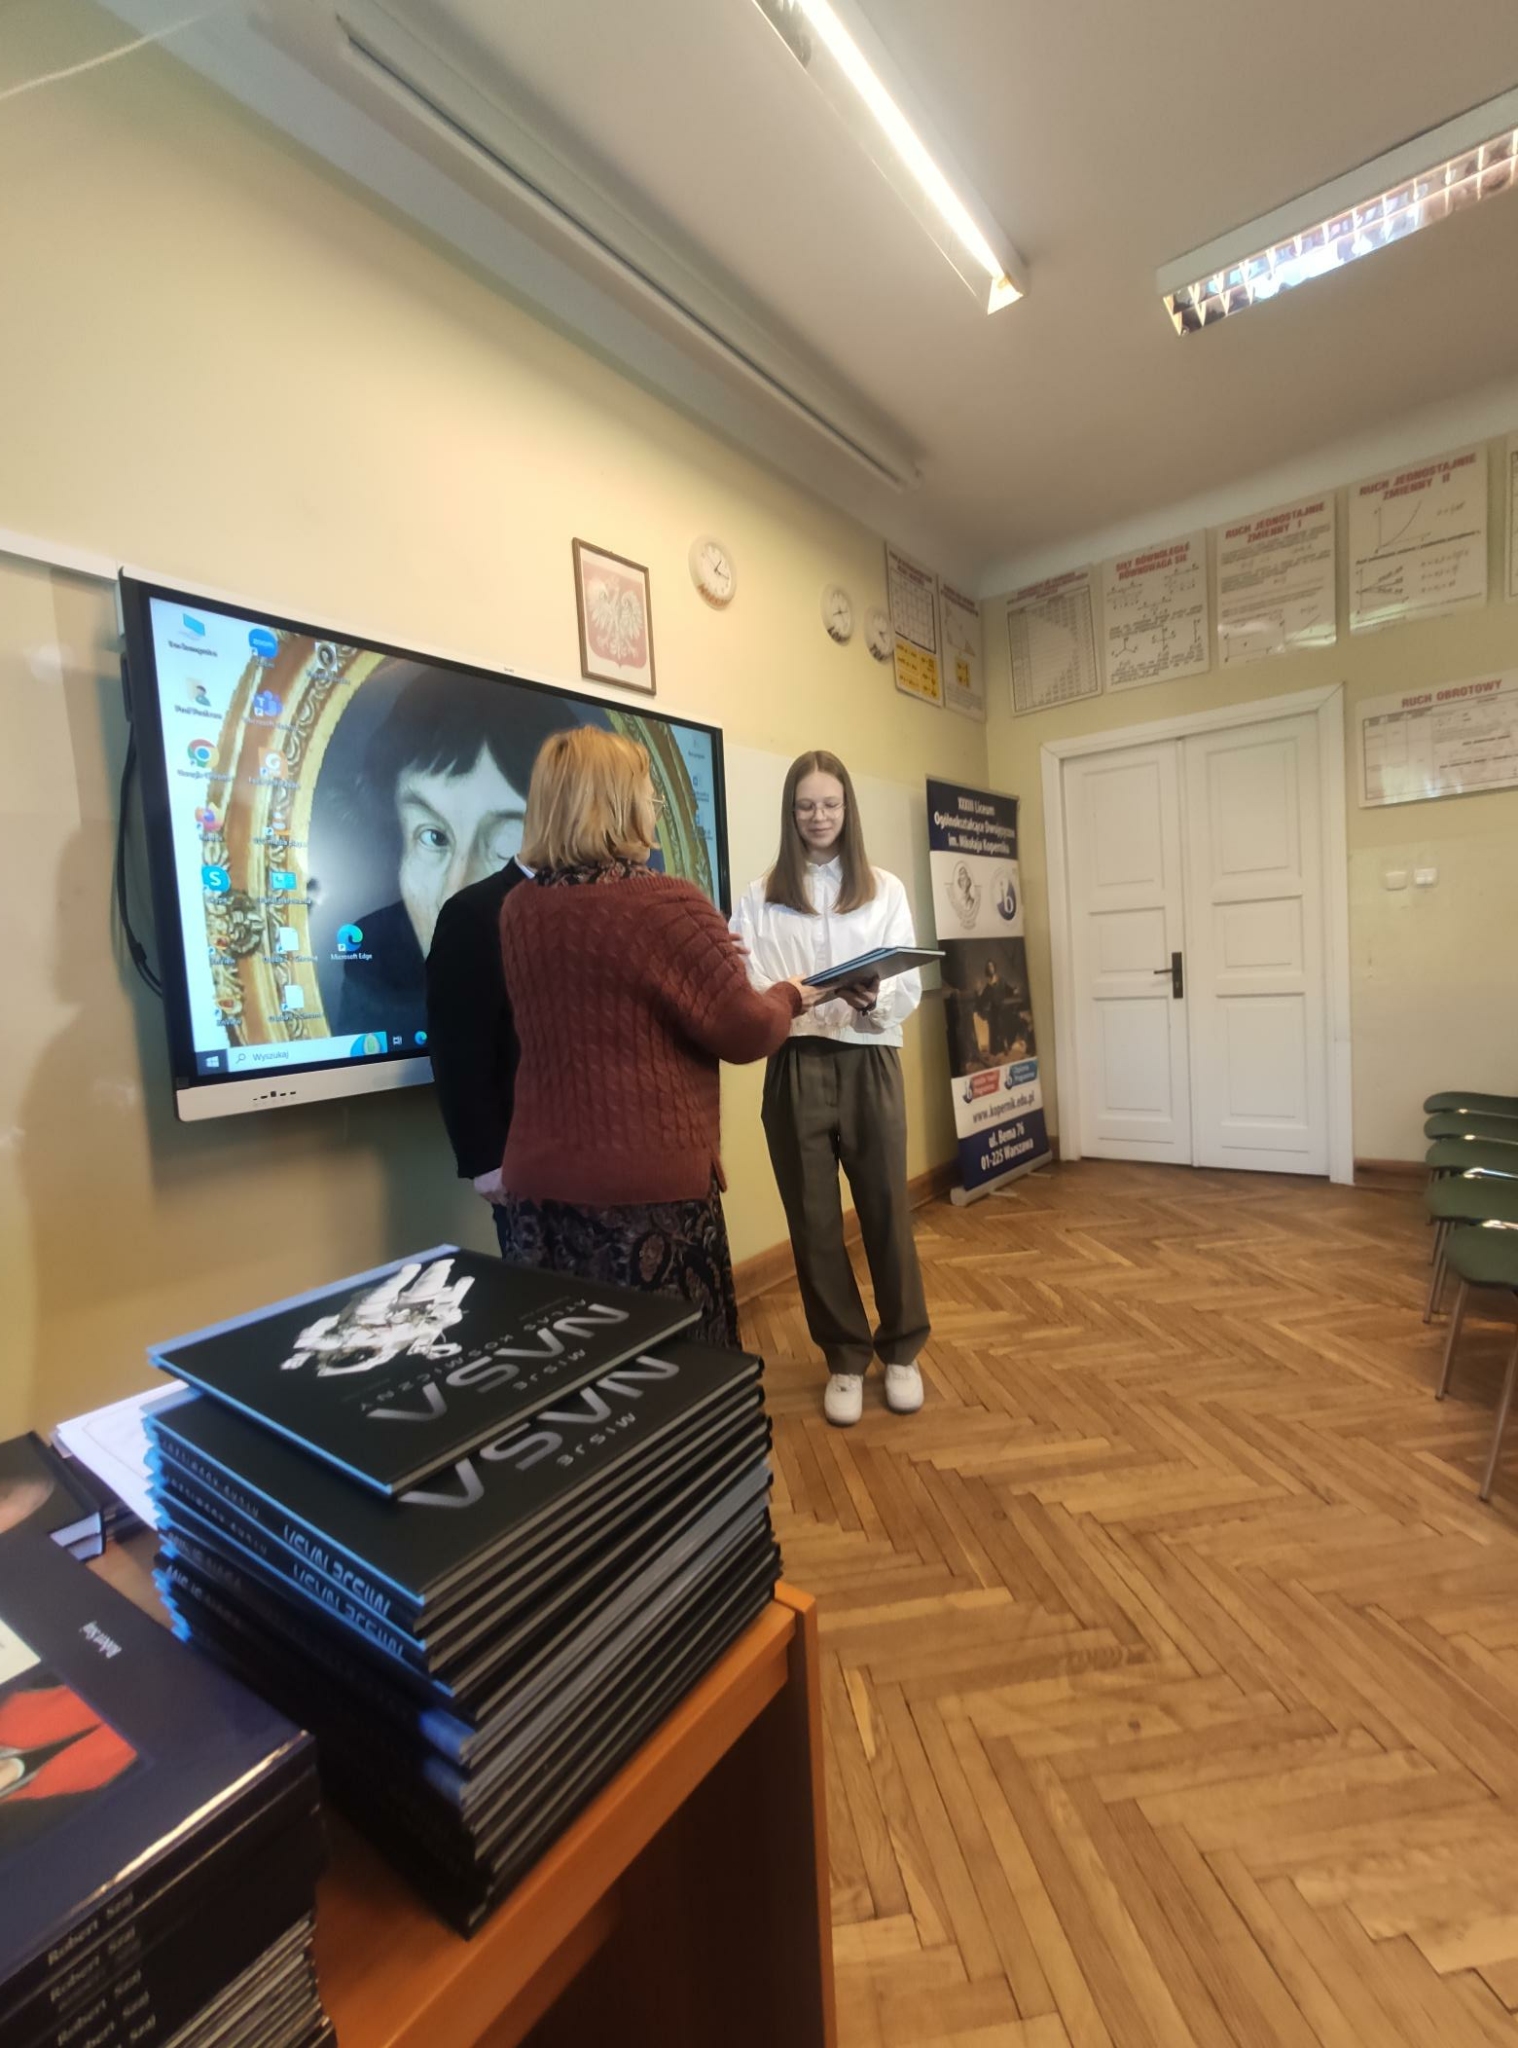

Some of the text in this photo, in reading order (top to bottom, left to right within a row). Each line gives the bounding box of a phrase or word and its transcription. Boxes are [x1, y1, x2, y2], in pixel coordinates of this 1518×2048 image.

[1225, 524, 1251, 540] RUCH
[1401, 679, 1503, 708] RUCH OBROTOWY
[330, 952, 373, 961] Microsoft Edge
[252, 1051, 289, 1063] Wyszukaj
[1003, 1138, 1034, 1160] Warszawa
[366, 1303, 631, 1423] NASA
[512, 1348, 587, 1392] MISJE
[398, 1355, 681, 1508] NASA
[556, 1411, 637, 1468] MISJE
[48, 1919, 98, 1966] Robert
